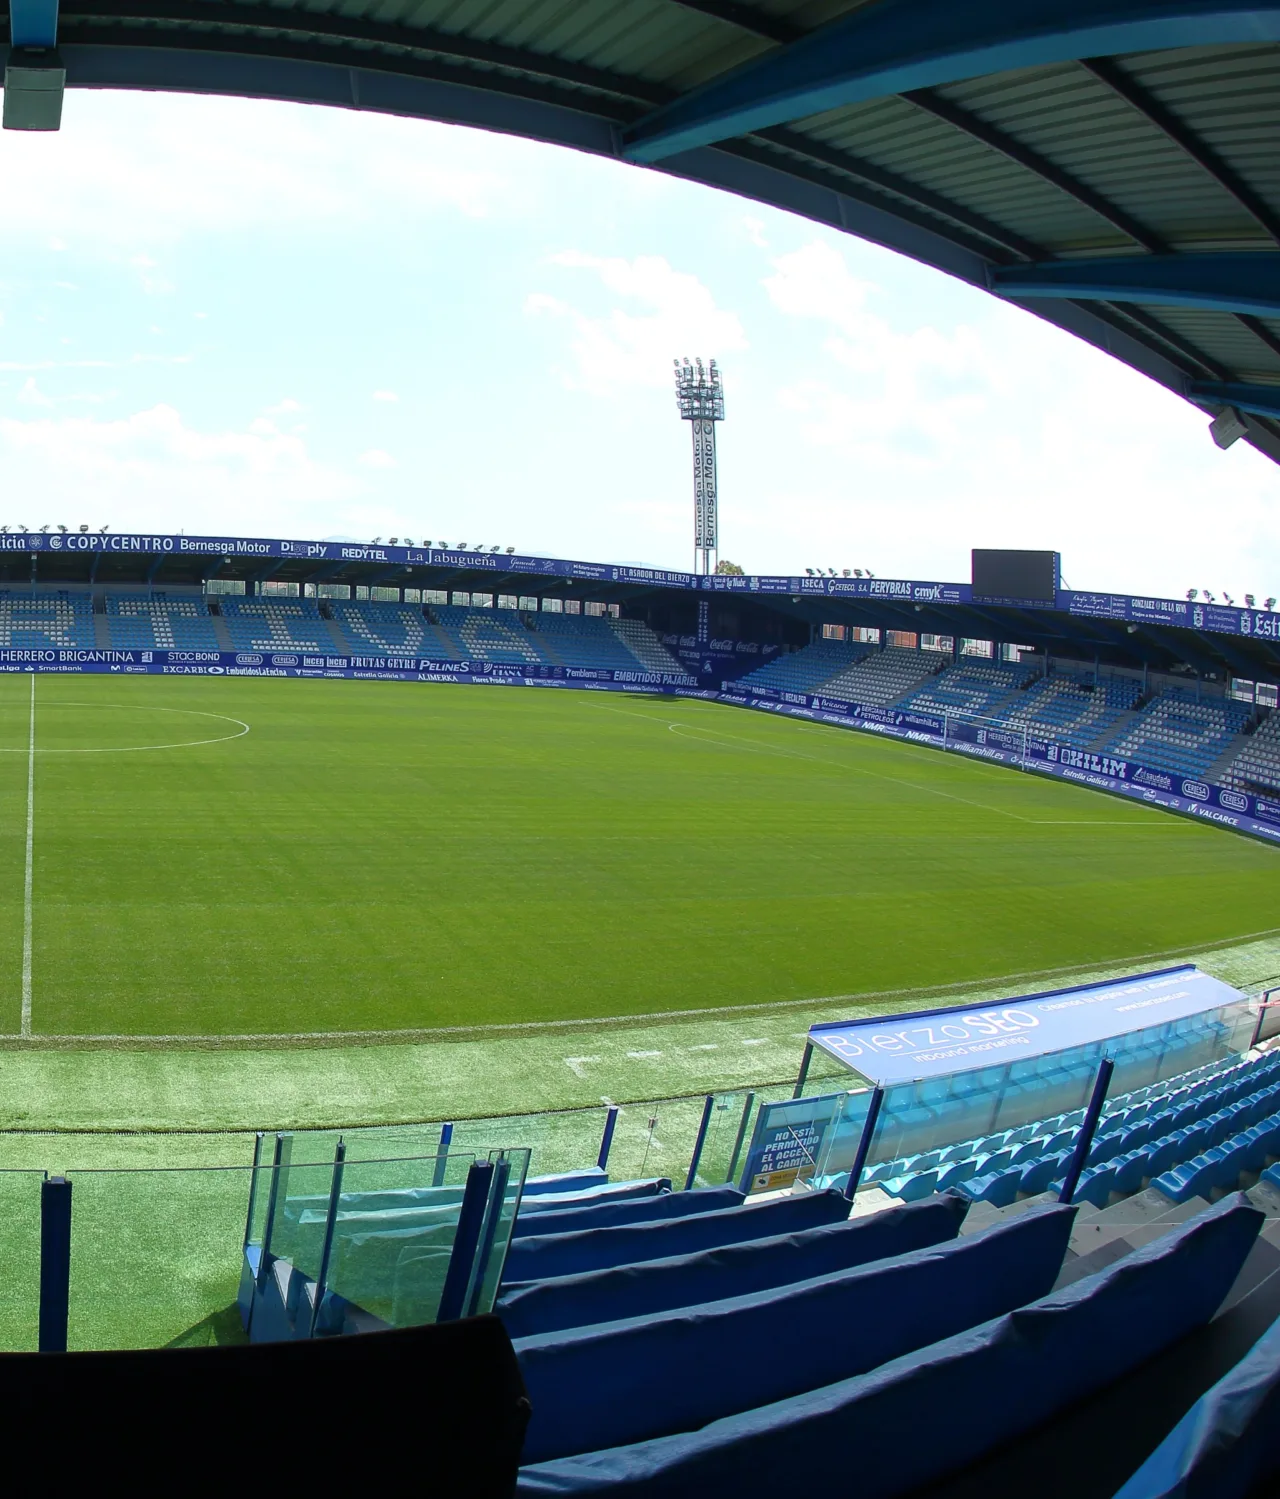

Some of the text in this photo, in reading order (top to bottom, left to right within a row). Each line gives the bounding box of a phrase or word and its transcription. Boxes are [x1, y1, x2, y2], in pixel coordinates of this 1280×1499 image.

[694, 438, 704, 547] Bernesga Motor
[704, 437, 716, 548] Bernesga Motor
[67, 536, 174, 550] COPYCENTRO
[180, 538, 271, 553] Bernesga Motor
[341, 548, 388, 560] REDYTEL
[407, 550, 496, 567] La Jabugueña
[620, 568, 627, 576] EL
[628, 569, 653, 579] ASADOR
[654, 572, 666, 580] DEL
[667, 574, 690, 583] BIERZO
[801, 579, 824, 588] ISECA
[870, 581, 911, 595] PERYBRAS
[914, 586, 941, 600] cmyk
[0, 651, 135, 662] HERRERO BRIGANTINA
[350, 657, 417, 669] FRUTAS GEYRE
[163, 666, 208, 674] EXCARBI
[417, 674, 459, 682] ALIMERKA
[613, 671, 699, 687] EMBUTIDOS PAJARIEL
[860, 712, 895, 723] PETROLEOS
[861, 721, 884, 732] NMR
[905, 730, 930, 742] NMR
[988, 732, 1012, 744] HERRERO
[953, 742, 1004, 760] williamhill.es
[1069, 751, 1128, 778] KILIM
[1062, 768, 1109, 787] Estrella Galicia
[1199, 808, 1240, 826] VALCARCE
[912, 1034, 1030, 1063] inbound marketing
[774, 1130, 790, 1142] NO
[764, 1135, 820, 1153] PERMITIDO
[761, 1153, 773, 1164] EL
[761, 1163, 774, 1173] AL
